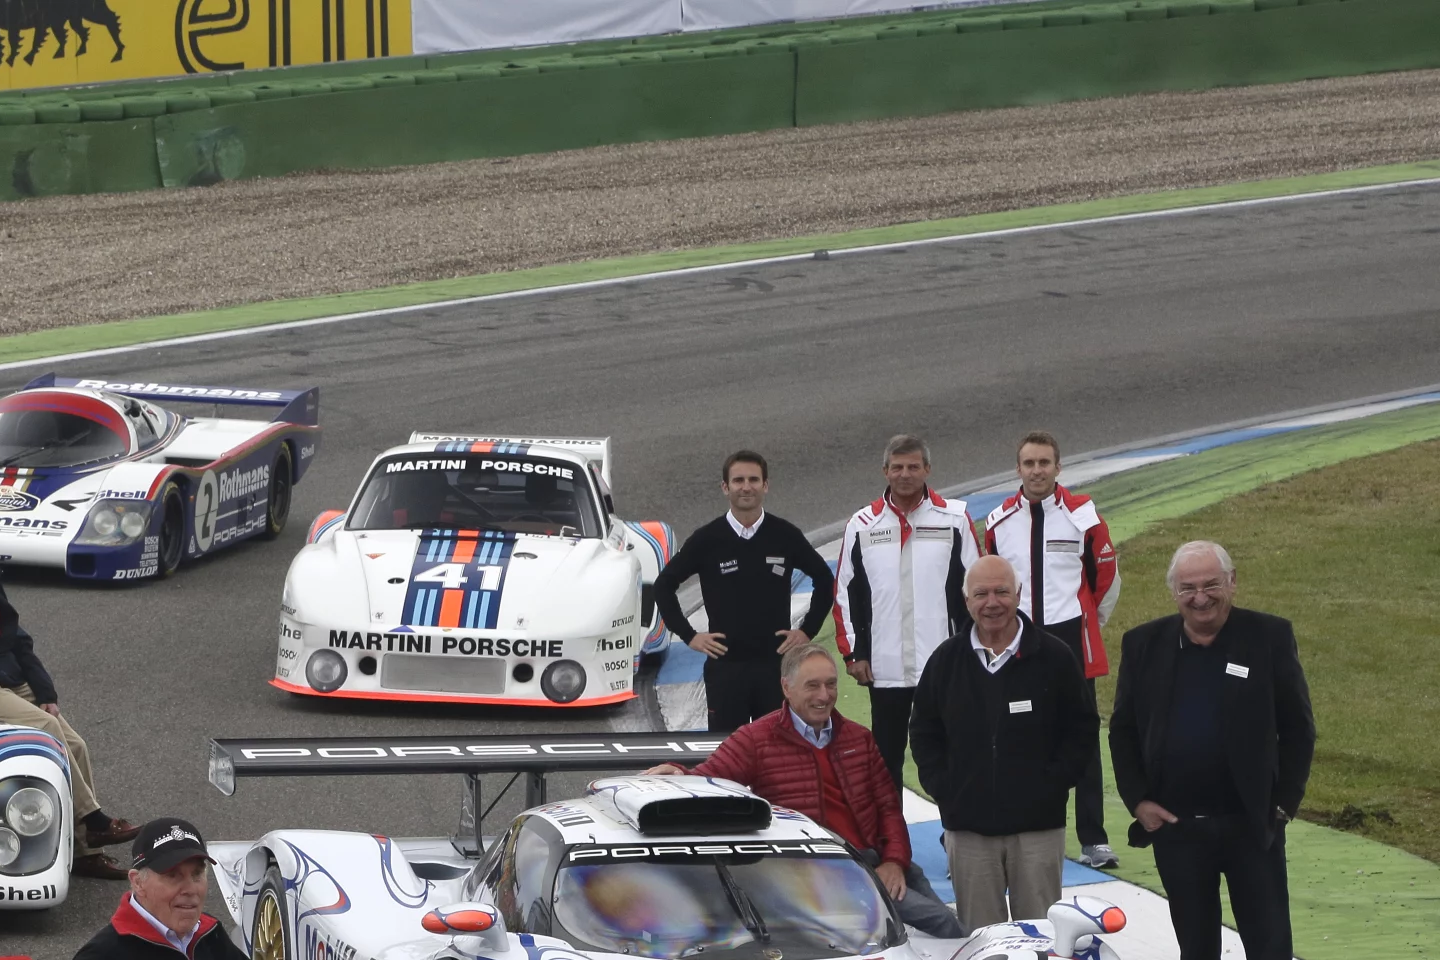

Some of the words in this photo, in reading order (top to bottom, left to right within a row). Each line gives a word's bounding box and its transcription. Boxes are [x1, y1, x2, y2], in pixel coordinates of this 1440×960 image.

[74, 379, 283, 399] Rothmans
[422, 435, 510, 444] MARTINI
[300, 443, 316, 460] Shell
[385, 460, 467, 474] MARTINI
[480, 460, 574, 480] PORSCHE
[219, 464, 270, 502] Rothmans
[98, 489, 147, 499] Shell
[201, 483, 213, 540] 2
[213, 514, 267, 545] PORSCHE
[144, 536, 160, 545] BOSCH
[112, 566, 159, 580] DUNLOP
[413, 563, 504, 591] 41
[611, 615, 635, 628] DUNLOP
[328, 629, 432, 653] MARTINI
[441, 636, 564, 658] PORSCHE
[604, 659, 629, 672] BOSCH
[241, 740, 726, 759] PORSCHE
[569, 844, 849, 861] PORSCHE
